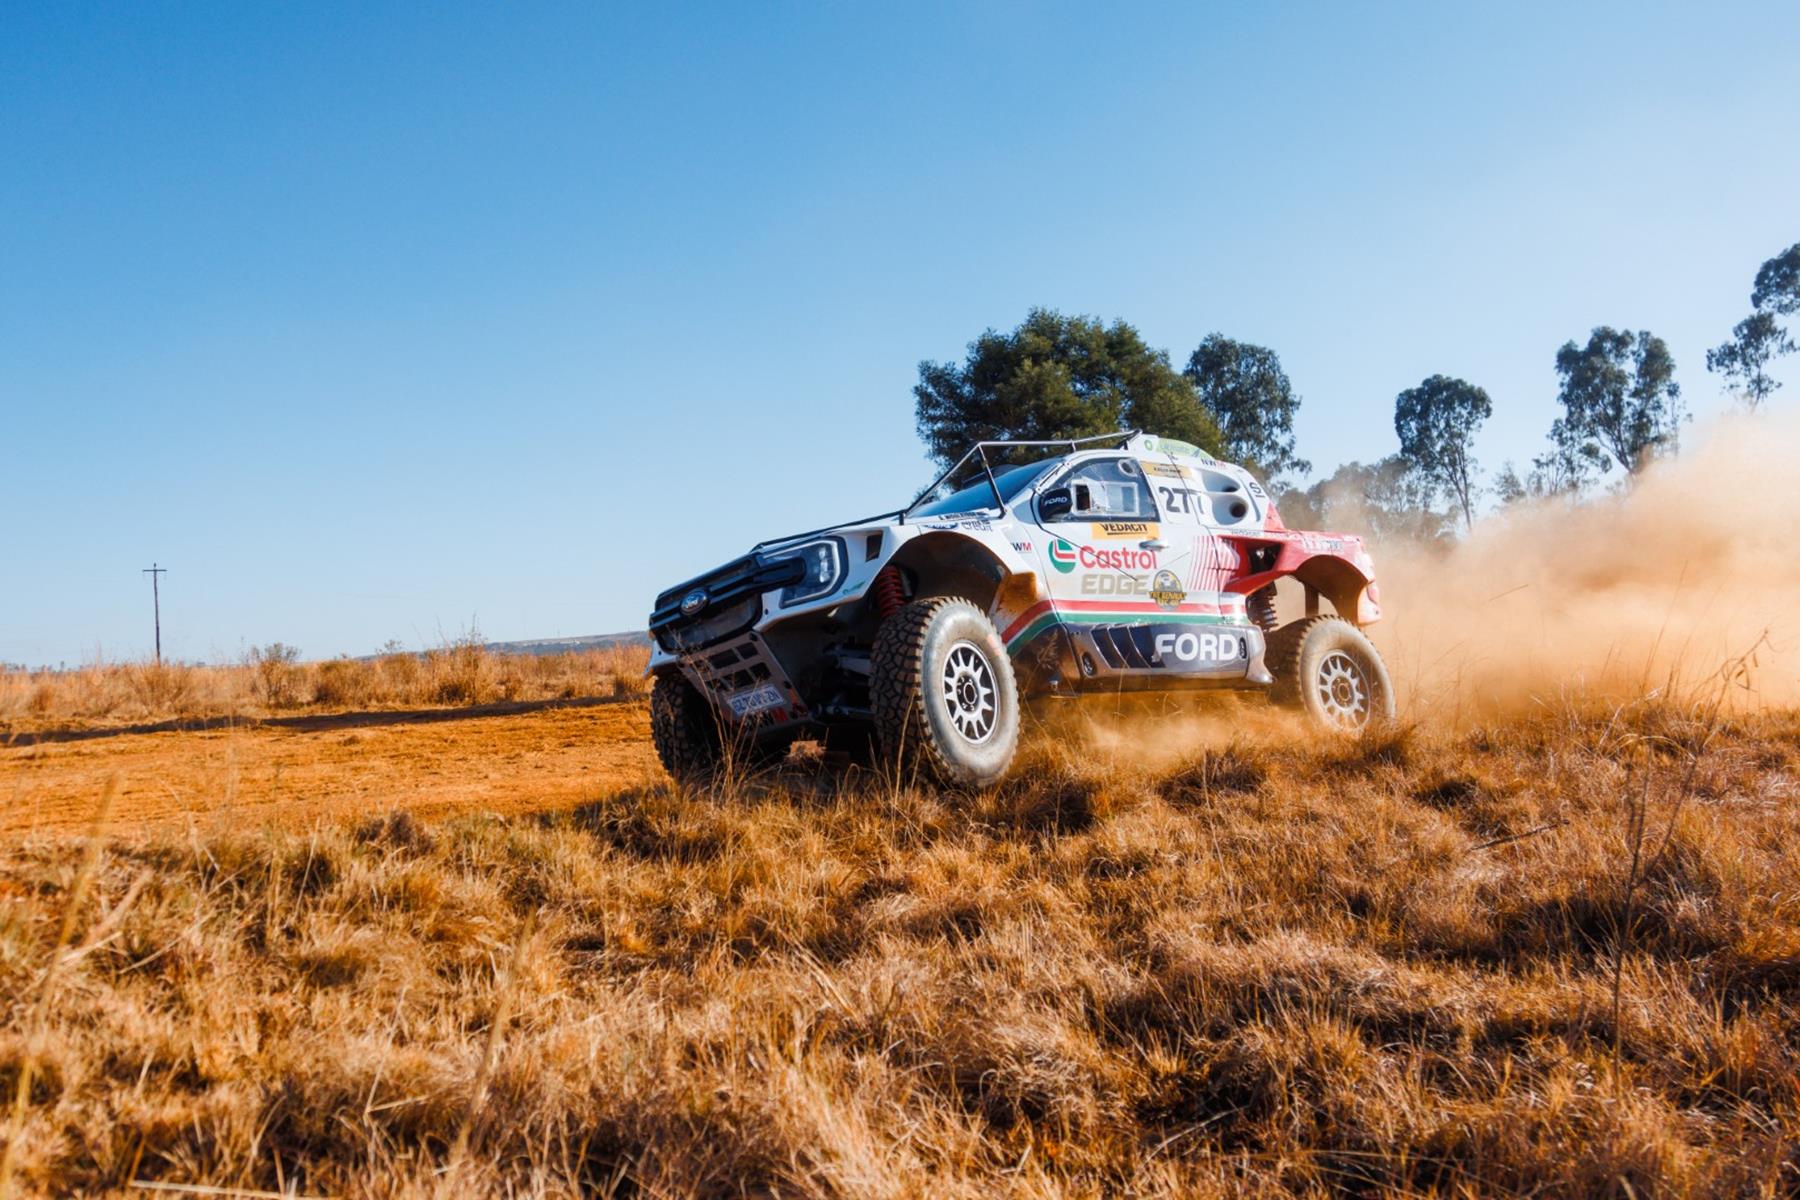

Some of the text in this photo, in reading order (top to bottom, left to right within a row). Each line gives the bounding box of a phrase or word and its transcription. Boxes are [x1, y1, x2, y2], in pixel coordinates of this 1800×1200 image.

[1044, 496, 1068, 506] FORD
[1099, 523, 1148, 532] VEDACIT
[1079, 545, 1158, 570] Castrol
[1081, 573, 1150, 595] EDGE
[1155, 633, 1239, 661] FORD
